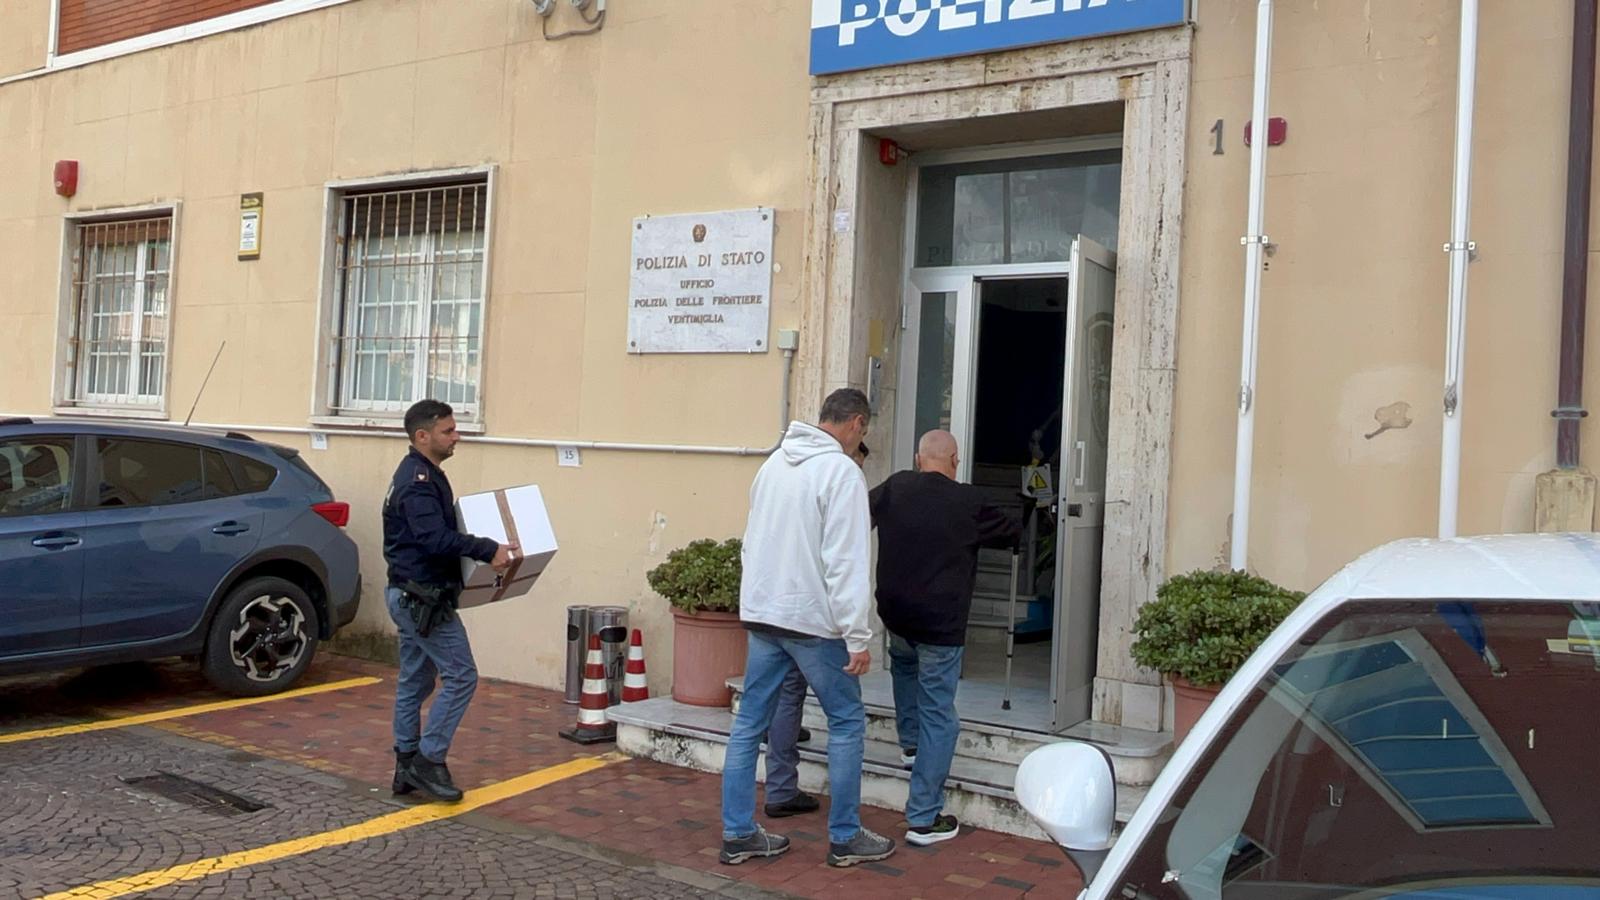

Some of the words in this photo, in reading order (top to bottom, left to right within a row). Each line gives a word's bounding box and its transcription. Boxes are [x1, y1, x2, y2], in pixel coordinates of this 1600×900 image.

[1210, 119, 1224, 155] 1
[636, 256, 687, 270] POLIZIA
[698, 254, 711, 267] DI
[721, 251, 765, 266] STATO
[680, 280, 714, 289] UFFICIO
[634, 299, 668, 308] POLIZIA
[676, 297, 704, 306] DELLE
[712, 295, 762, 305] FRONTIERE
[668, 314, 724, 324] VENTIMIGLIA
[565, 450, 574, 460] 15
